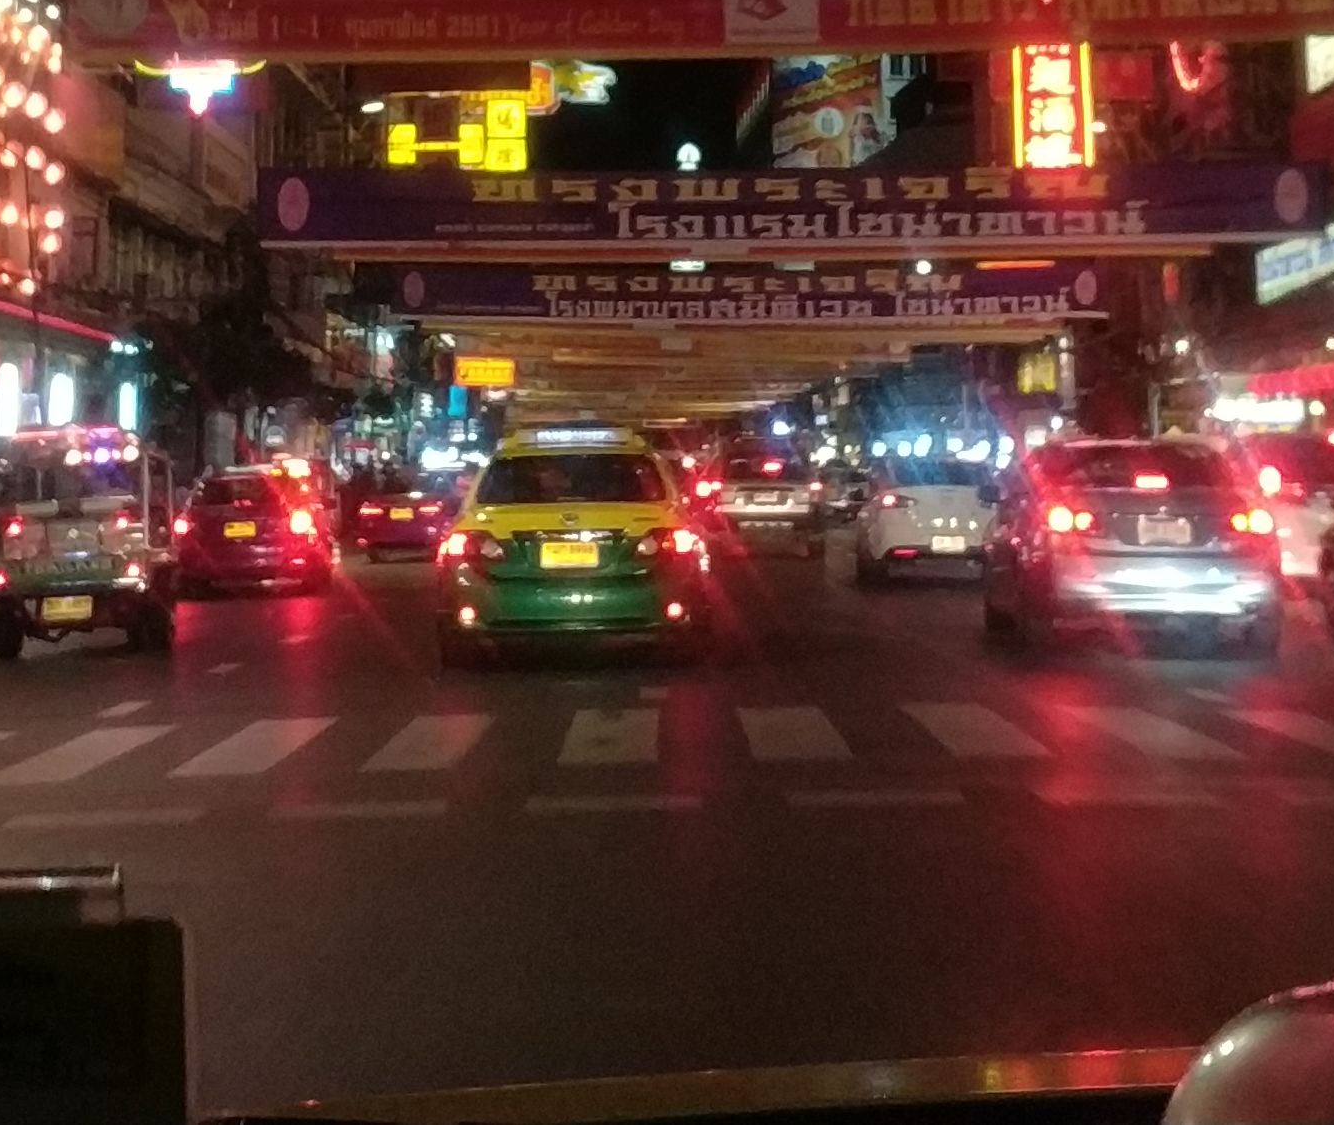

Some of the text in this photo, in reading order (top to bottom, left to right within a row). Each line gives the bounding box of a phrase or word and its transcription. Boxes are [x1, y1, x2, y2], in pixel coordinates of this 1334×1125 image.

[472, 165, 1110, 203] ทรงพระเจริญ
[609, 199, 1150, 239] โรงแรมไชน่าทาวน์
